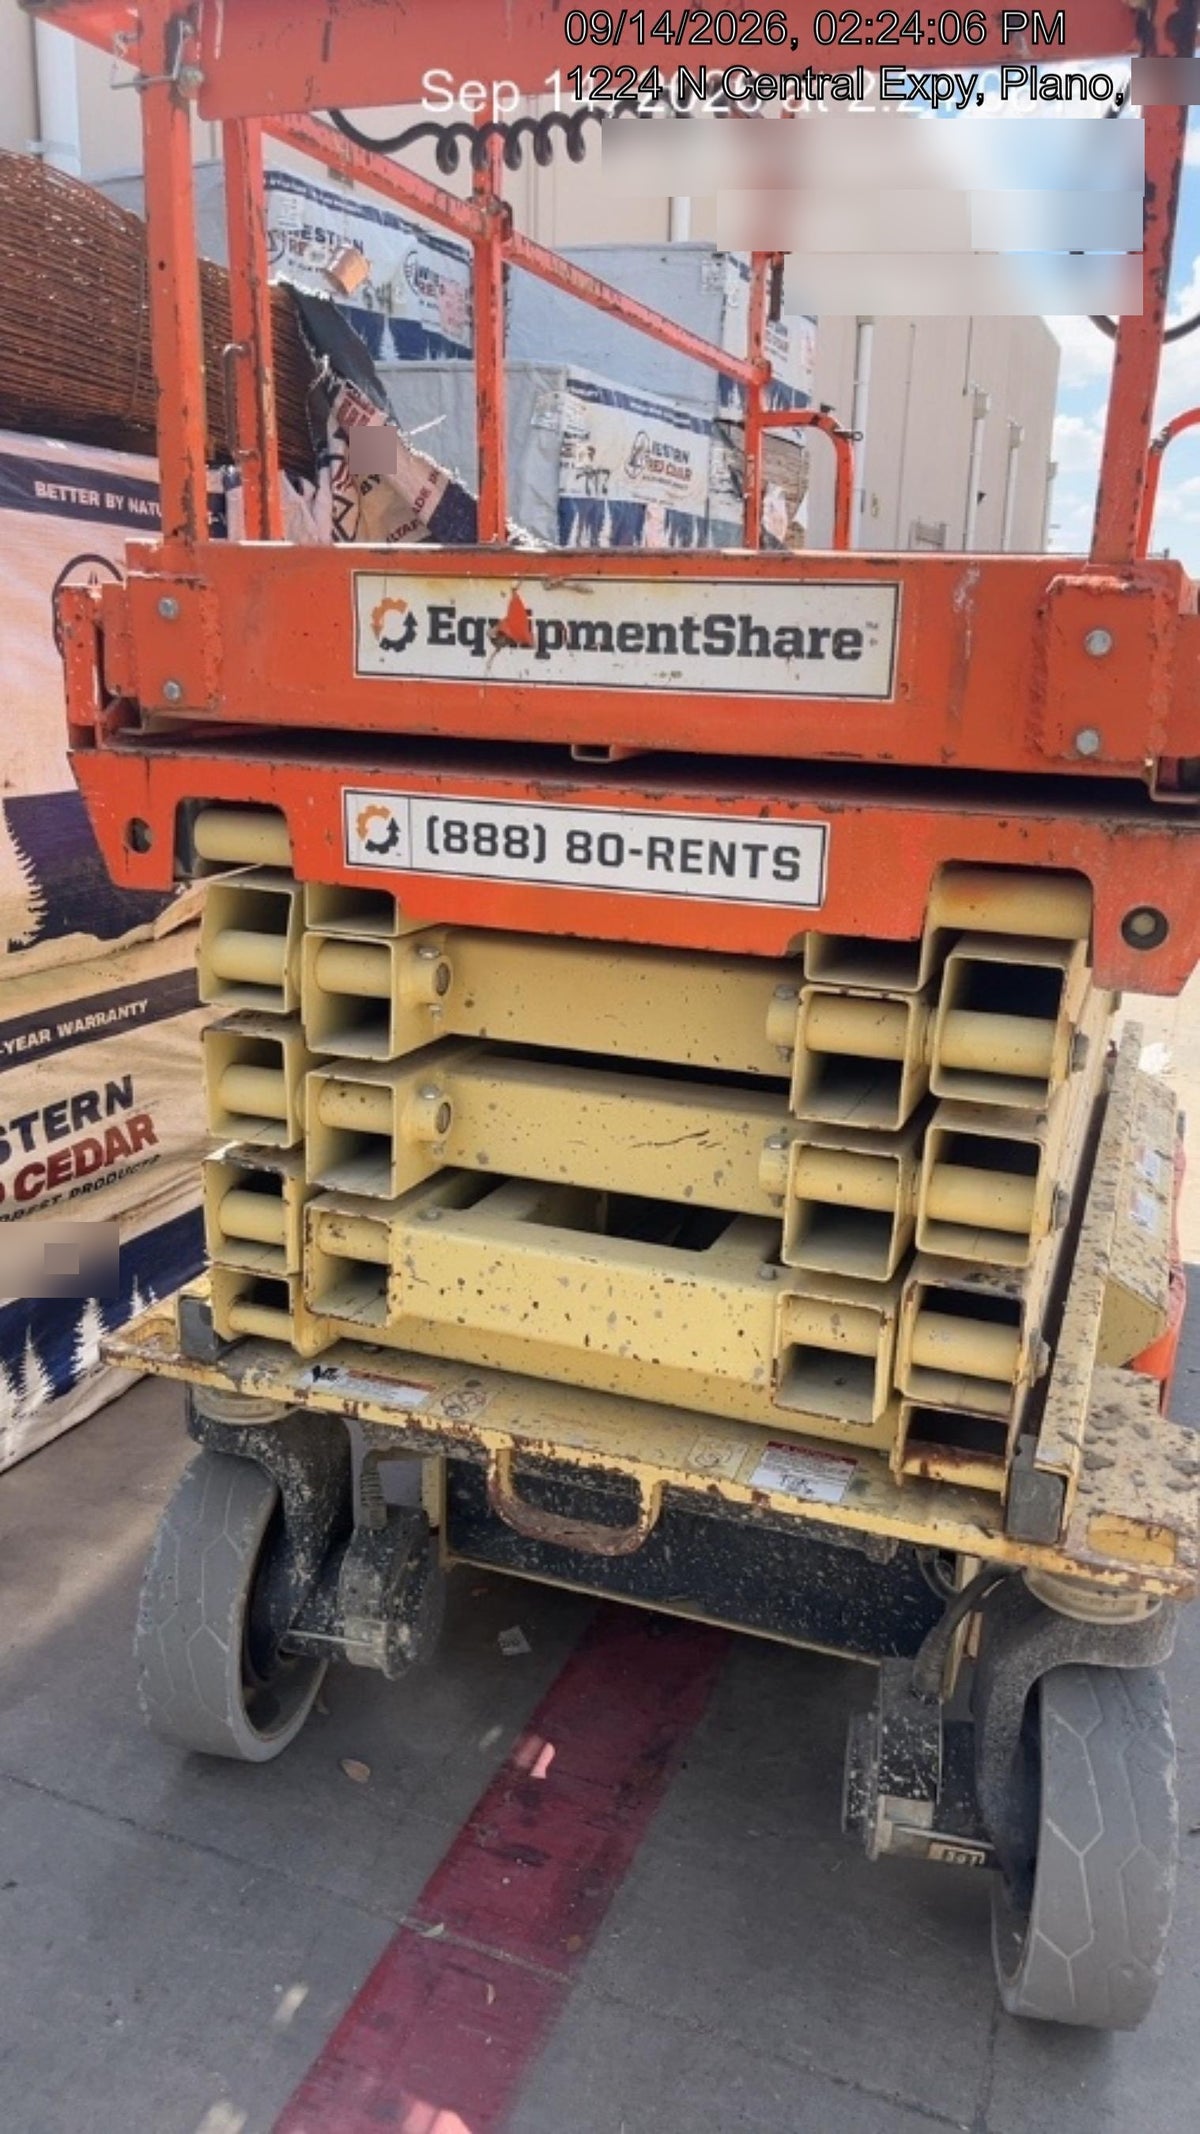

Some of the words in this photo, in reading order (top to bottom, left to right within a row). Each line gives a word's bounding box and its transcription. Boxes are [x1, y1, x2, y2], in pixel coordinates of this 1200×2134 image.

[34, 481, 100, 508] BETTER
[105, 492, 124, 511] BY
[128, 498, 162, 518] NATU
[426, 815, 546, 864] (888)
[566, 830, 801, 882] 80-RENTS
[57, 1000, 148, 1038] WARRANTY
[14, 1113, 159, 1203] CEDAR
